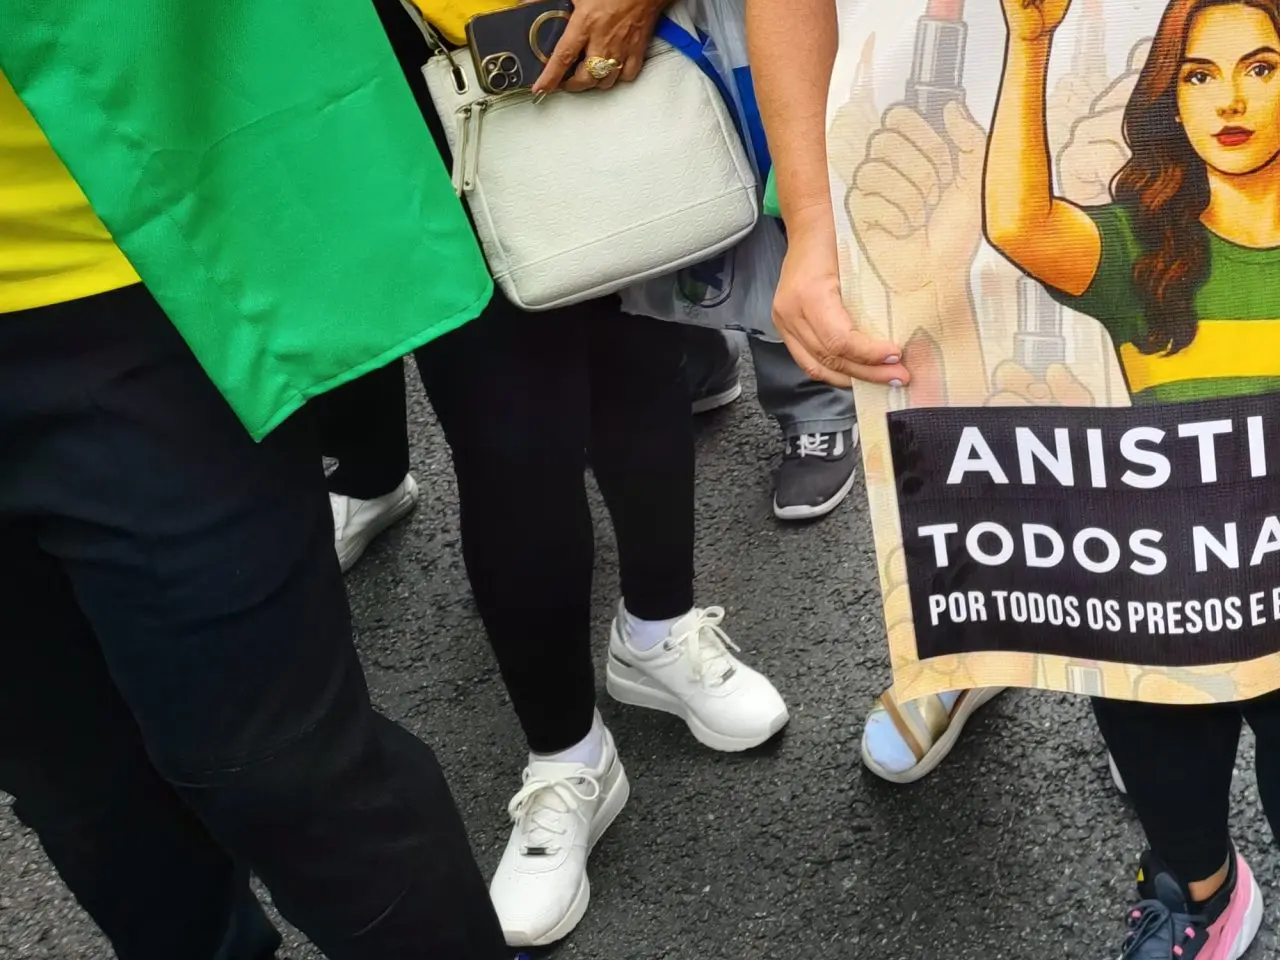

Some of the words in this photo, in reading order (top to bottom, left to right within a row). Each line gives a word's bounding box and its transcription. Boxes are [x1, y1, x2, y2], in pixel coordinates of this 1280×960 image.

[917, 521, 1168, 576] TODOS
[929, 590, 988, 626] POR
[991, 590, 1081, 628] TODOS
[1086, 597, 1122, 632] OS
[1128, 597, 1243, 635] PRESOS
[1249, 591, 1267, 627] E
